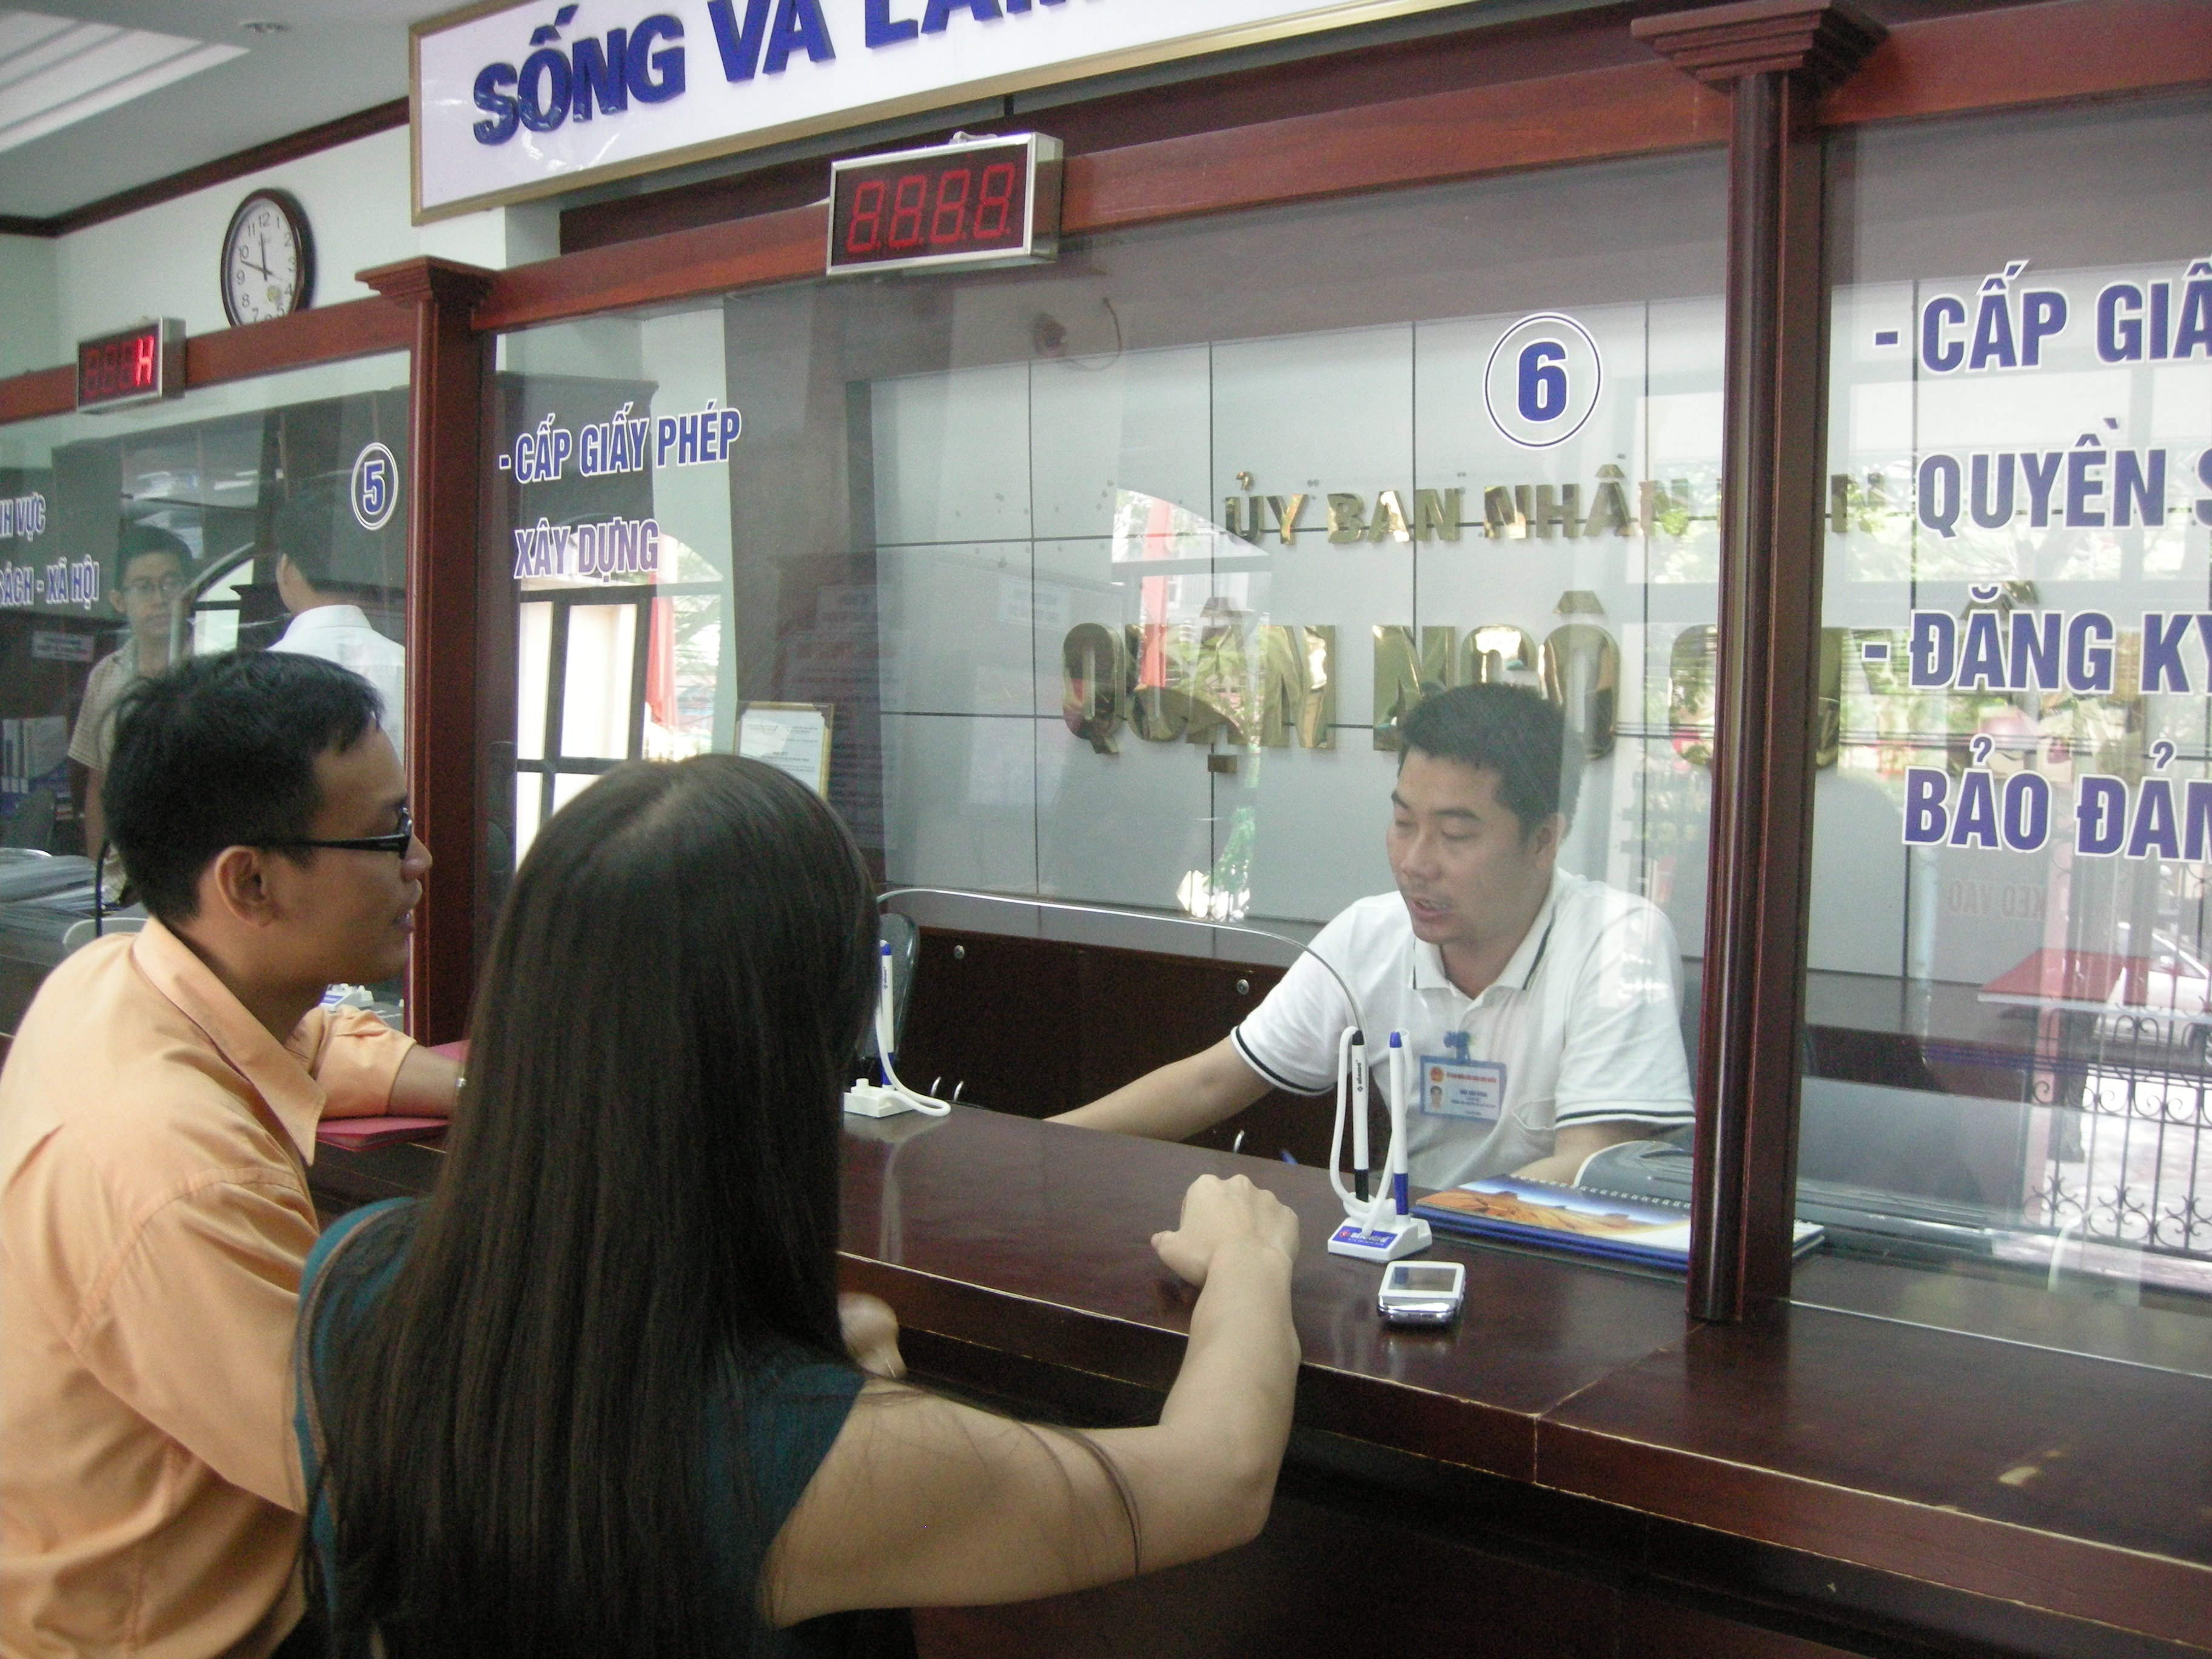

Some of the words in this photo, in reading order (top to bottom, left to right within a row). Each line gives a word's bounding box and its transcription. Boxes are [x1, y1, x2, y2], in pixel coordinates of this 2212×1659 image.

[472, 4, 686, 146] SỐNG
[1919, 259, 2071, 375] CẤP
[1516, 337, 1569, 424] 6
[515, 413, 572, 484] CẤP
[578, 401, 649, 477] GIẤY
[655, 398, 742, 469] PHÉP
[1915, 414, 2170, 541] QUYỀN
[15, 491, 46, 542] VỰC
[362, 459, 386, 515] 5
[1225, 471, 1309, 546] ỦY
[1326, 488, 1461, 545] BAN
[1484, 464, 1689, 539] NHÂN
[46, 556, 69, 604] XÃ
[71, 554, 100, 611] HỘI
[513, 517, 571, 580] XÂY
[577, 516, 660, 583] DỰNG
[1908, 583, 2117, 695] ĐĂNG
[1902, 733, 2053, 854] BẢO
